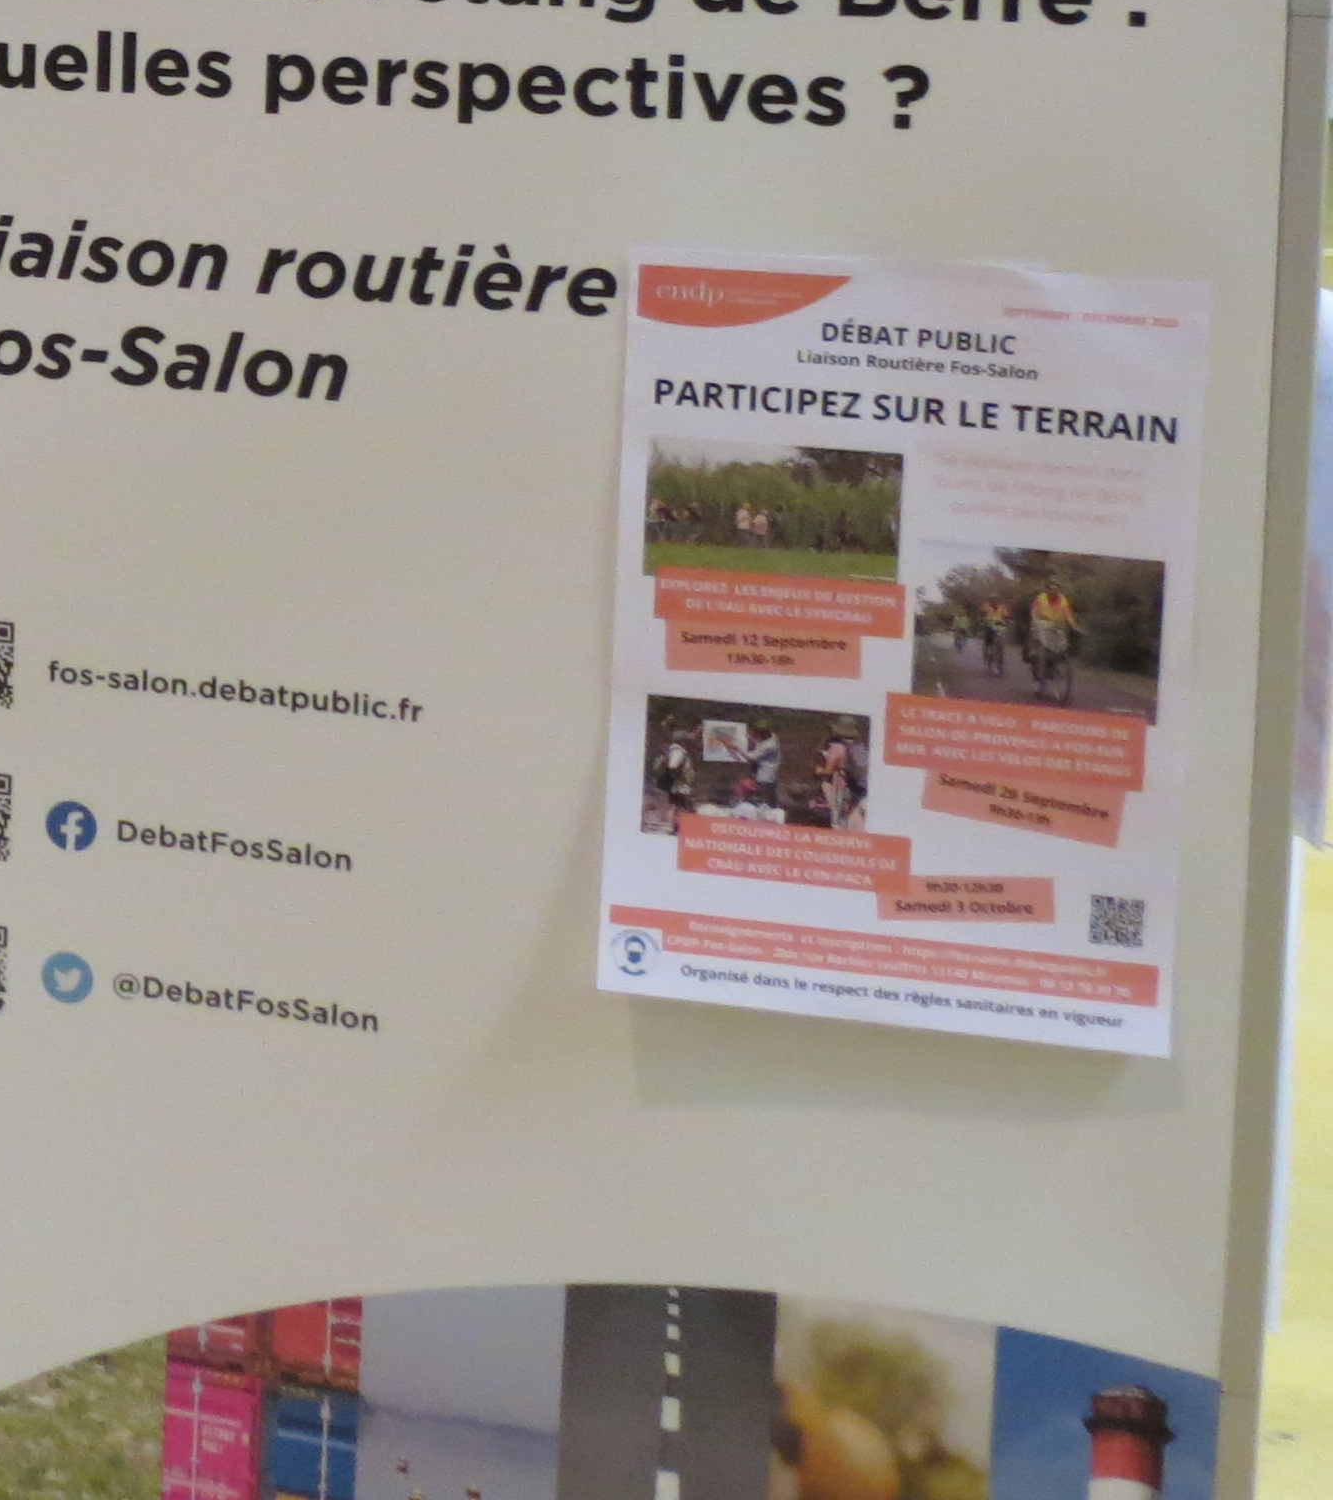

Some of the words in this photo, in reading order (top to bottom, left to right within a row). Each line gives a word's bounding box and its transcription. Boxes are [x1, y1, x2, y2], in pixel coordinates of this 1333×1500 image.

[265, 50, 847, 128] perspectives
[883, 65, 932, 129] ?
[256, 242, 617, 317] routière
[797, 350, 860, 367] Liaison
[866, 354, 945, 374] Routière
[950, 361, 1039, 380] Fos-Salon
[822, 318, 909, 347] DÉBAT
[918, 328, 1017, 355] PUBLIC
[654, 379, 862, 419] PARTICIPEZ
[872, 394, 946, 425] SUR
[959, 401, 999, 430] LE
[1011, 404, 1178, 444] TERRAIN
[681, 631, 738, 646] Samedi
[742, 634, 759, 647] 12
[763, 635, 848, 651] Septembre
[49, 661, 423, 723] fos-salon.debatpublic.fr
[116, 820, 354, 871] DebatFosSalon
[113, 972, 380, 1032] @DebatFosSalon
[680, 964, 749, 984] Organisé
[753, 972, 790, 990] dans
[794, 978, 808, 991] le
[812, 983, 868, 999] respect
[873, 986, 902, 1002] des
[904, 990, 952, 1008] règles
[956, 996, 1034, 1018] sanitaires
[1039, 1007, 1059, 1020] en
[1062, 1010, 1125, 1028] vigueur
